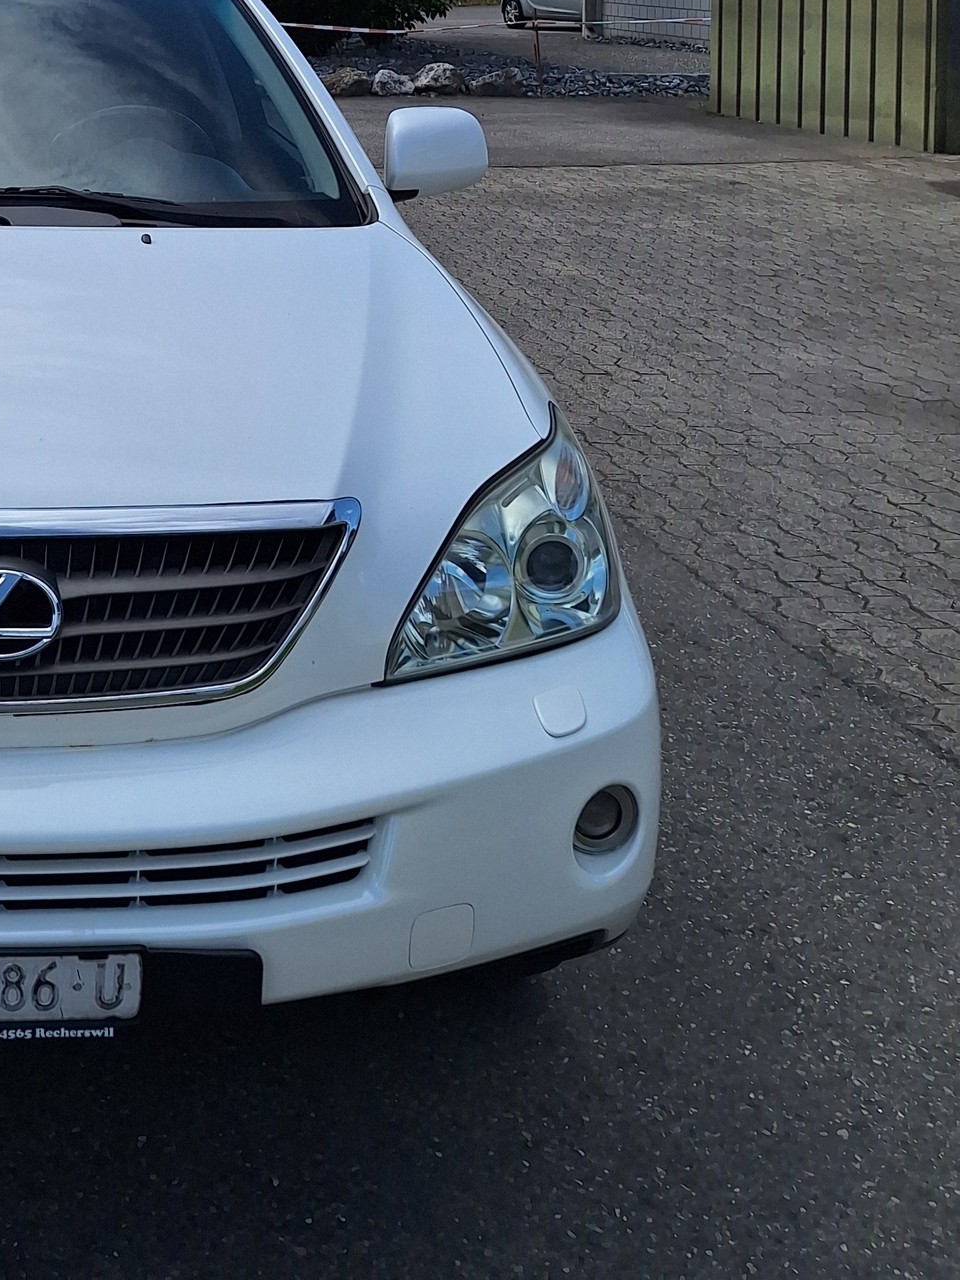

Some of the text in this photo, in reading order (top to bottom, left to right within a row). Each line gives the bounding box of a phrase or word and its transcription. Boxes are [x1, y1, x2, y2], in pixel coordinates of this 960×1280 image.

[95, 963, 126, 1010] U
[0, 1028, 33, 1040] 4565
[35, 1026, 115, 1039] Recherswil
